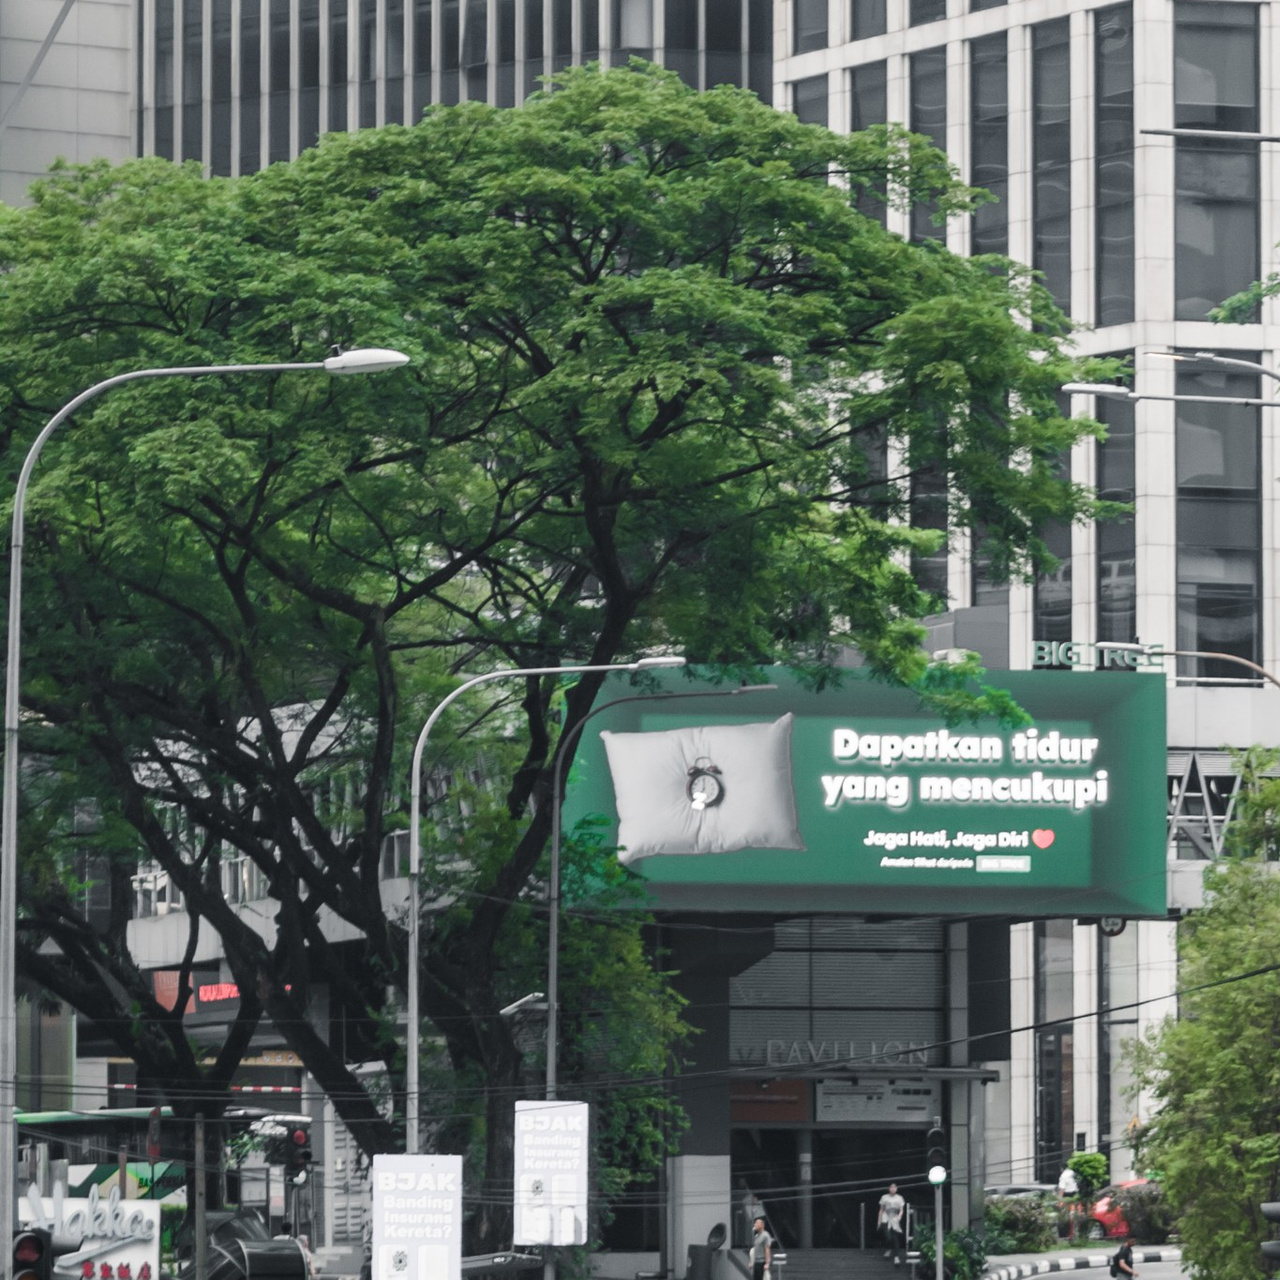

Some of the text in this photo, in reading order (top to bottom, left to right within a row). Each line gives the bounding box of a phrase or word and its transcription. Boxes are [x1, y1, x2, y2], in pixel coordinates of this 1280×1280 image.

[1033, 640, 1081, 666] BIG
[833, 728, 1099, 767] Dapatkan tidur
[821, 770, 1109, 810] yang mencukupi
[863, 830, 1030, 852] Jaga Hati, Jaga Diri
[766, 1039, 928, 1065] PAVILION
[519, 1115, 583, 1132] BJAK
[523, 1134, 581, 1149] Banding
[524, 1158, 580, 1170] Kereta?
[378, 1172, 457, 1192] BJAK
[383, 1195, 454, 1212] Banding
[384, 1225, 453, 1239] Kereta?
